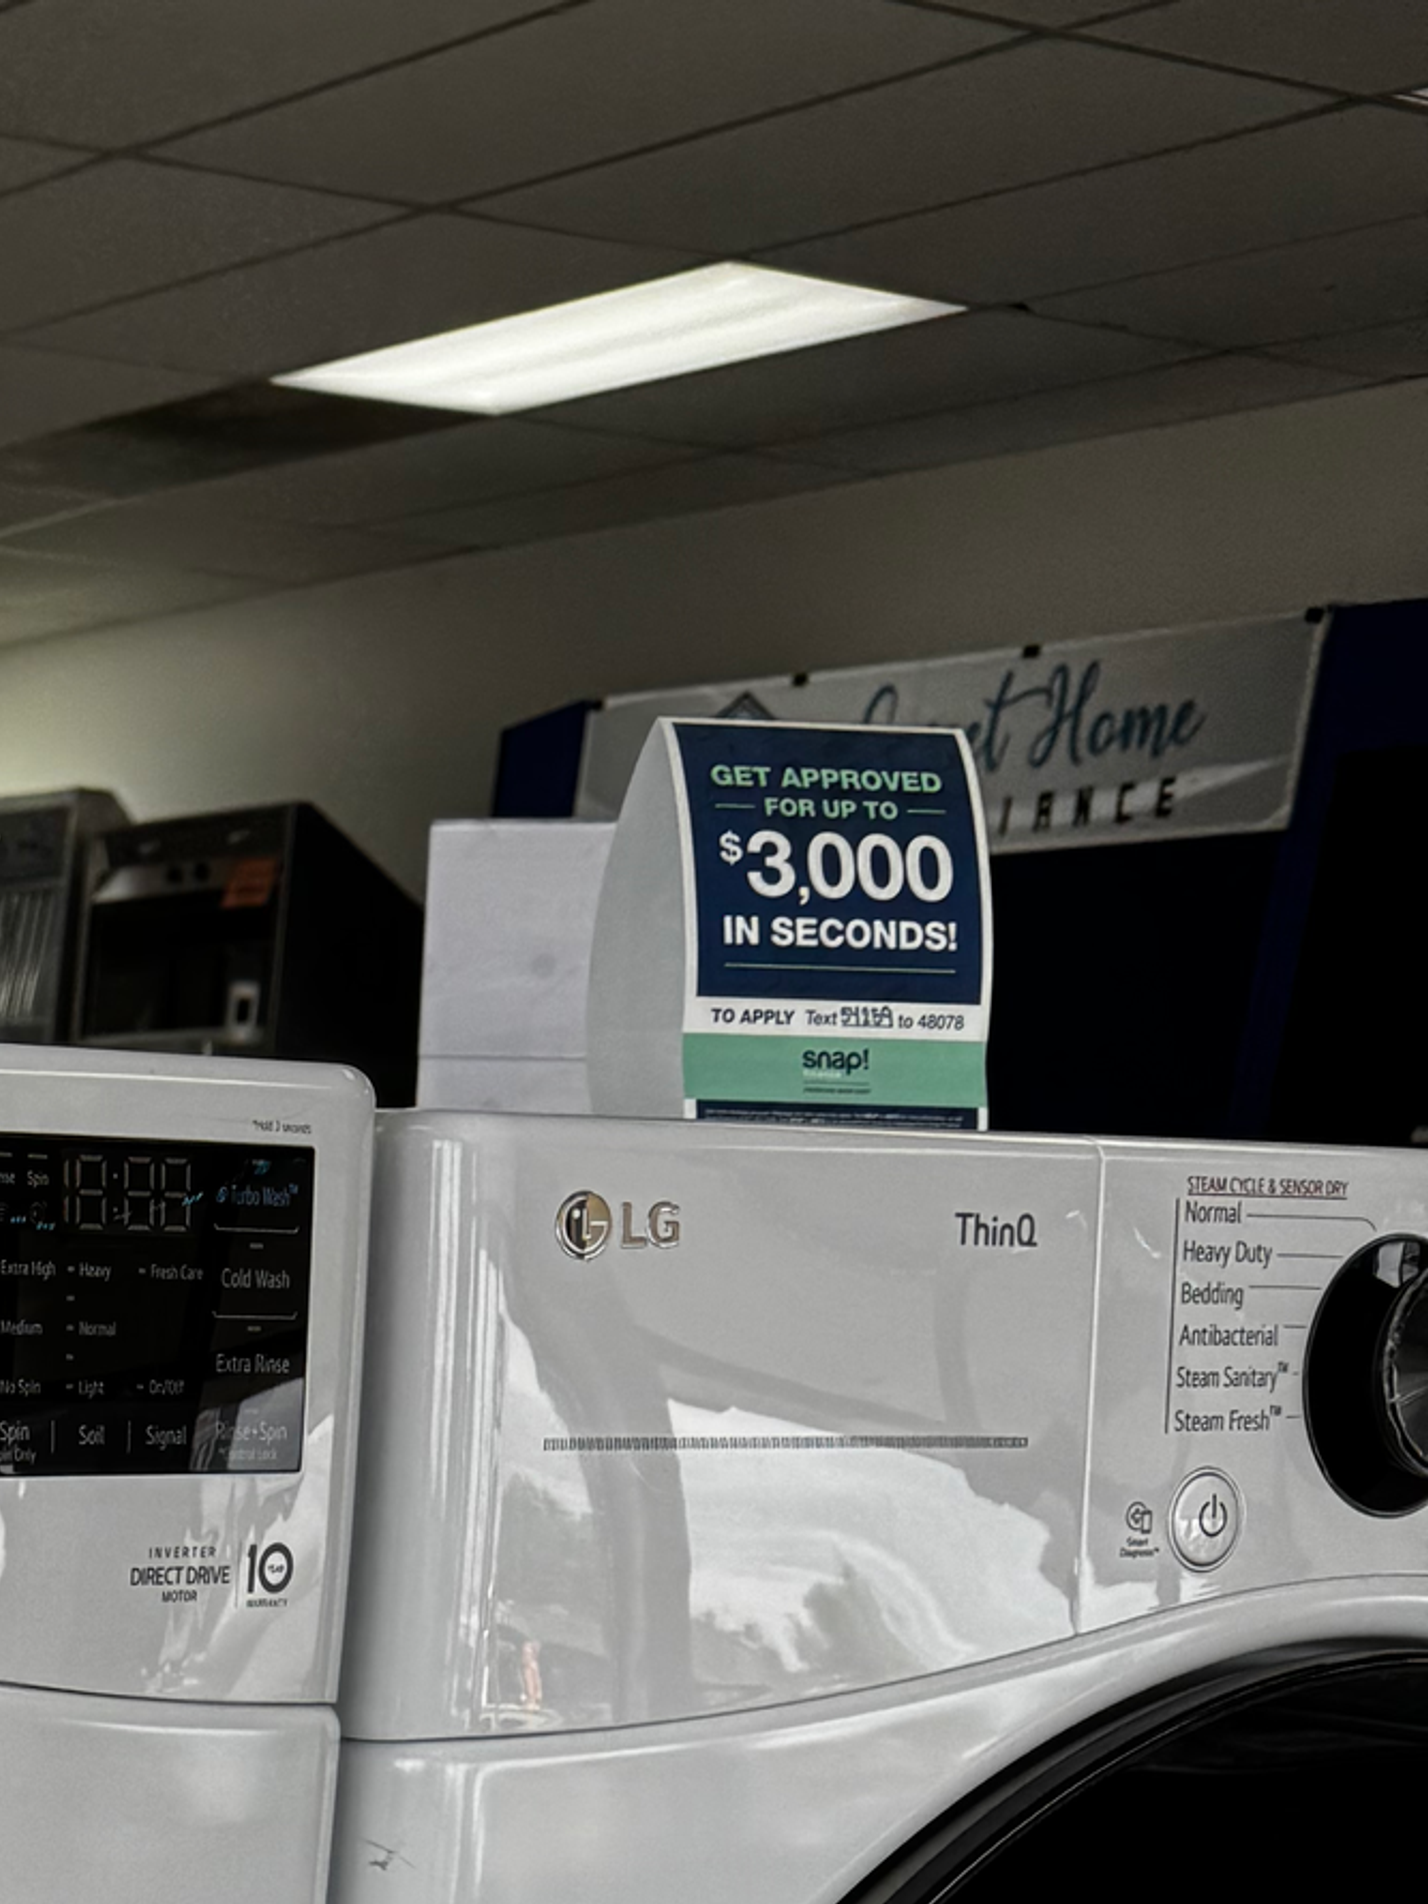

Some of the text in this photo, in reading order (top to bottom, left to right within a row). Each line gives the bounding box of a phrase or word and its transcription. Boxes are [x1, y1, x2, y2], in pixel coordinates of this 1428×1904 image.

[1029, 659, 1206, 770] Home
[710, 764, 943, 794] GET APPROVED
[763, 796, 899, 821] FOR UP TO
[717, 828, 955, 906] $3,000
[722, 914, 959, 952] IN SECONDS!
[710, 1007, 965, 1031] TO APPLY Text to 48078
[802, 1048, 870, 1076] snap!
[1186, 1175, 1349, 1197] STEAM CYCLE SENSOR DRY
[1184, 1200, 1243, 1224] Normal
[619, 1200, 1039, 1250] LG ThinQ
[1182, 1239, 1273, 1269] Heavy Duty
[0, 1258, 57, 1281] Extra High
[78, 1261, 112, 1281] Heavy
[150, 1262, 204, 1281] Fresh Care
[220, 1267, 291, 1290] Cold Wash
[1180, 1281, 1245, 1311] Bedding
[0, 1319, 44, 1336] Medium
[78, 1321, 117, 1337] Normal
[1178, 1323, 1279, 1347] Antibacterial
[215, 1352, 291, 1374] Extra Rinse
[0, 1379, 42, 1397] No Spin
[1175, 1365, 1220, 1388] Steam
[77, 1380, 105, 1399] Light
[1173, 1408, 1224, 1433] Steam
[77, 1423, 106, 1446] Soil
[145, 1424, 187, 1451] Signal
[148, 1545, 218, 1560] INVERTER
[129, 1564, 232, 1587] DIRECT DRIVE
[246, 1541, 295, 1595] 10
[161, 1588, 198, 1603] MOTOR
